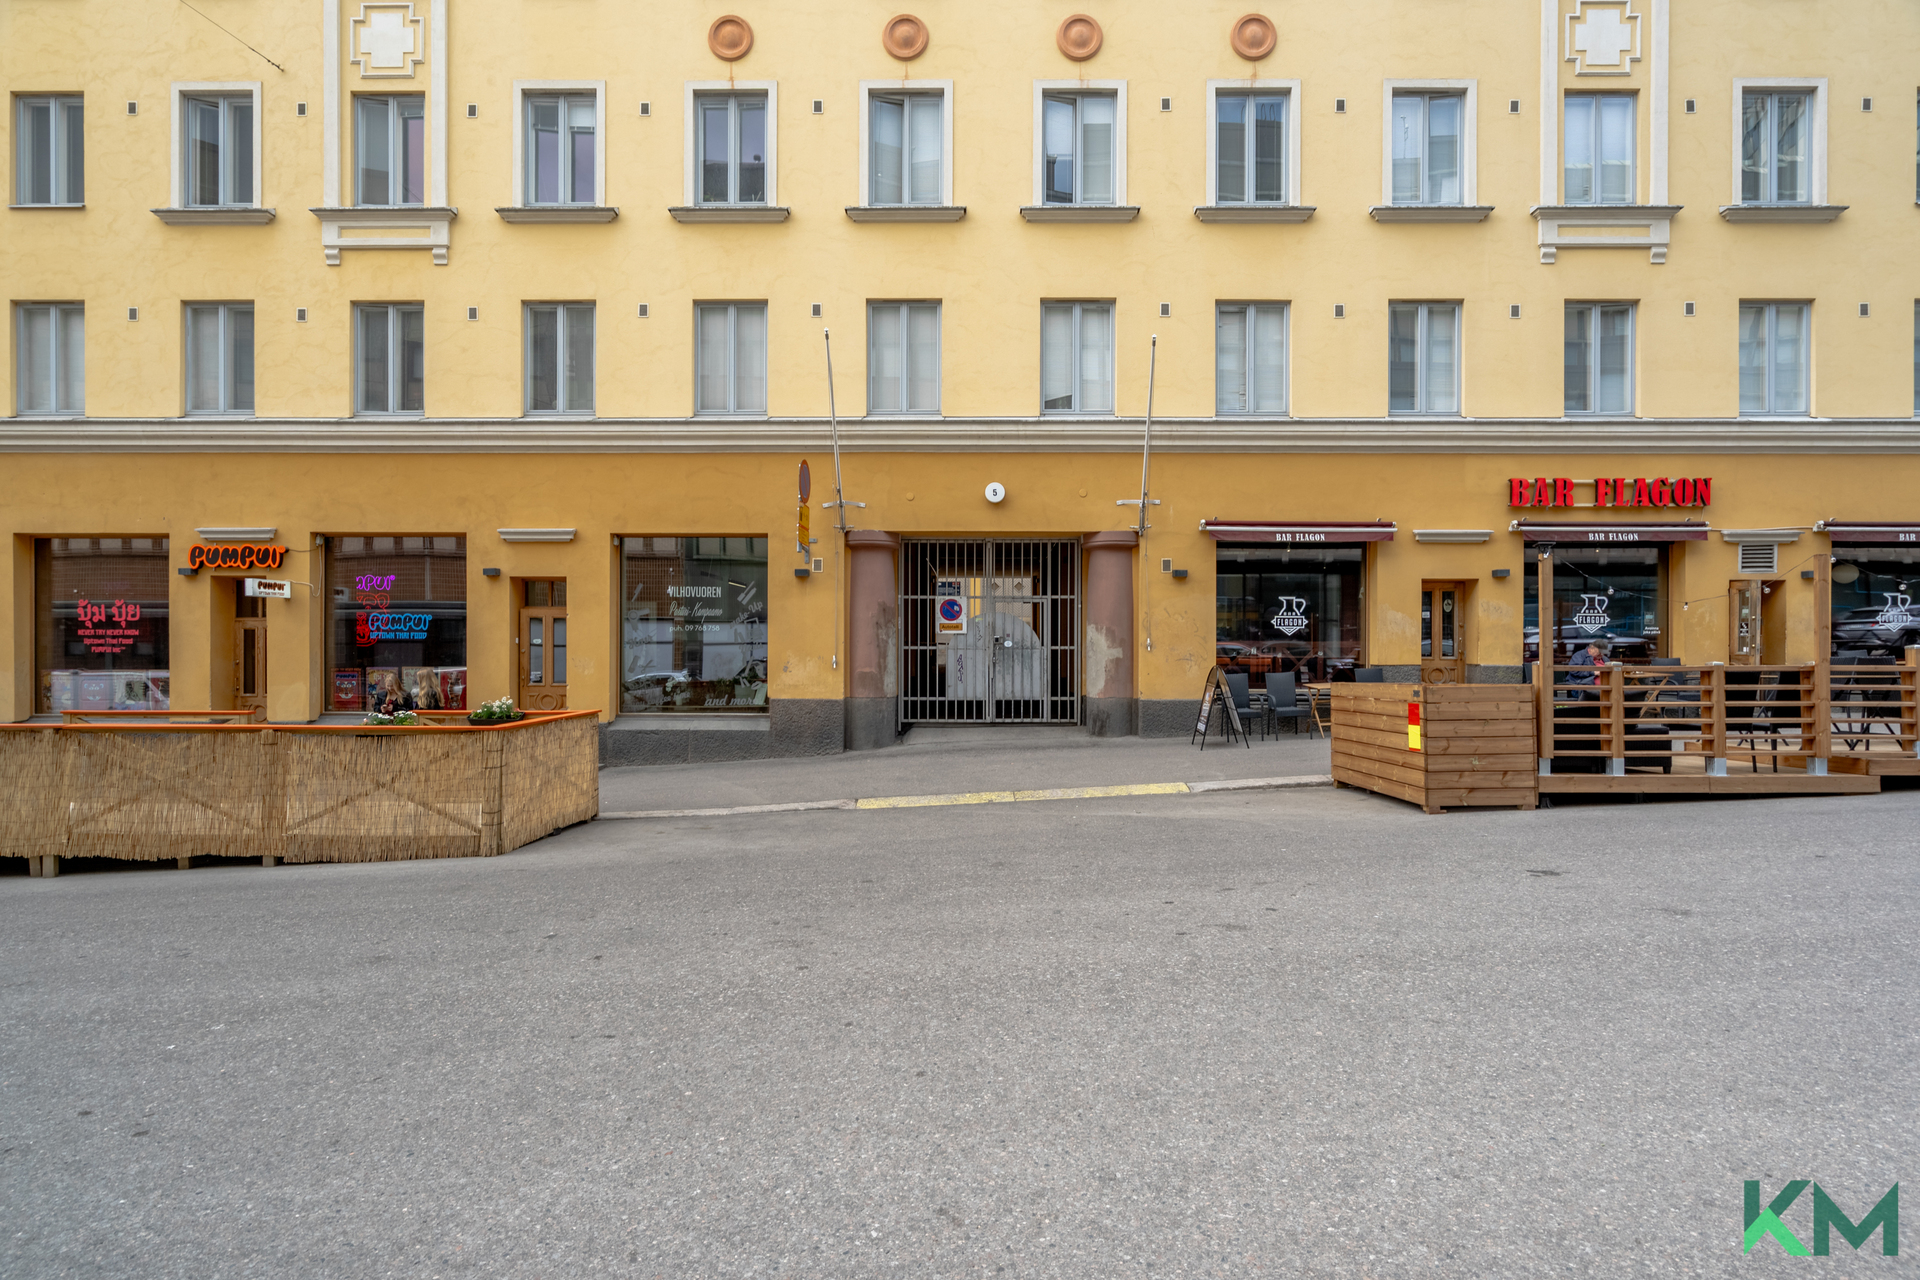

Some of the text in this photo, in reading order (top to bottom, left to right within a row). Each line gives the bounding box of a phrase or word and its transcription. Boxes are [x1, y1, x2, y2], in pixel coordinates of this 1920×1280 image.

[992, 488, 998, 497] 5
[1508, 477, 1712, 506] BAR FLAGON
[1275, 533, 1326, 542] BAR FLAGON
[1588, 532, 1639, 541] BAR FLAGON
[1899, 533, 1916, 541] BAR
[257, 580, 286, 591] PUMPUI
[668, 586, 722, 598] VILHOVUOREN
[1277, 618, 1302, 626] FLAGON
[1579, 616, 1604, 624] FLAGON
[704, 694, 728, 706] and
